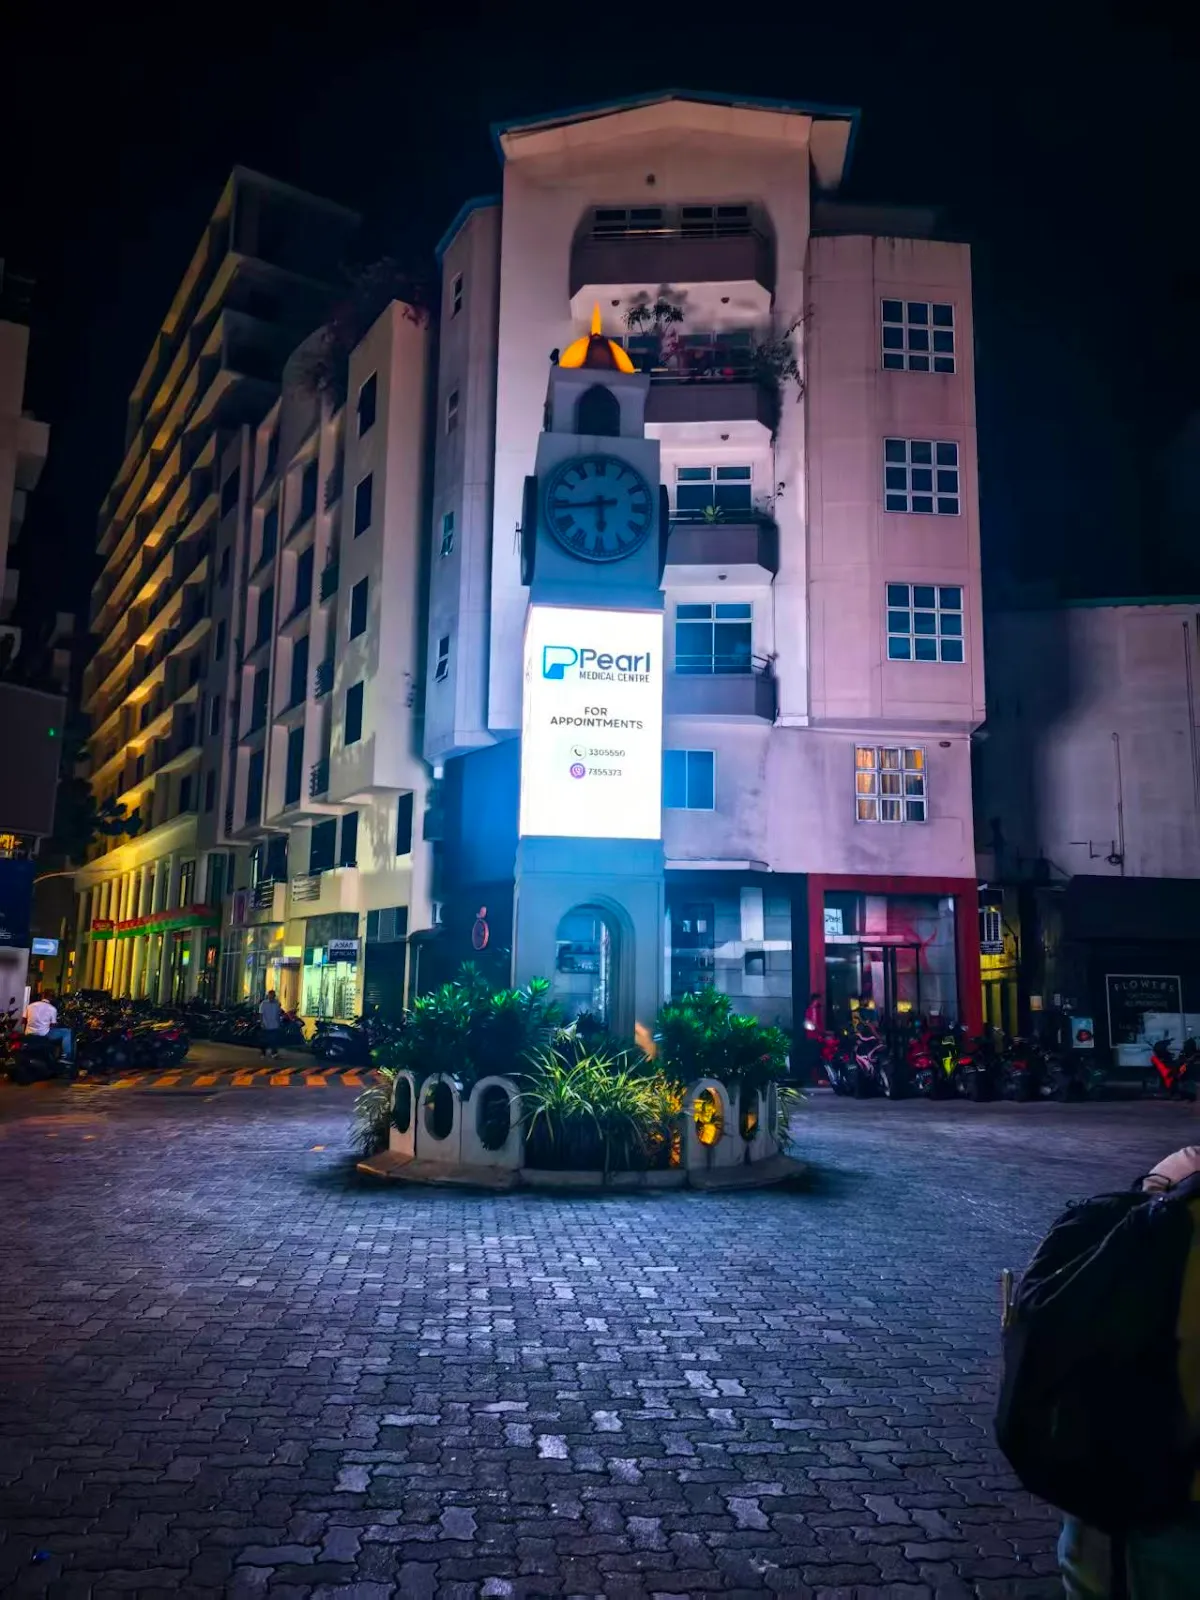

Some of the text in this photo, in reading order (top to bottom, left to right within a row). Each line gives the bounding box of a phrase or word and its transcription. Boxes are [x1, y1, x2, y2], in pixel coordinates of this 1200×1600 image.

[580, 648, 651, 673] Pearl
[579, 670, 650, 683] MEDICAL CENTRE
[584, 706, 608, 716] FOR
[550, 716, 644, 730] APPOINTMENTS
